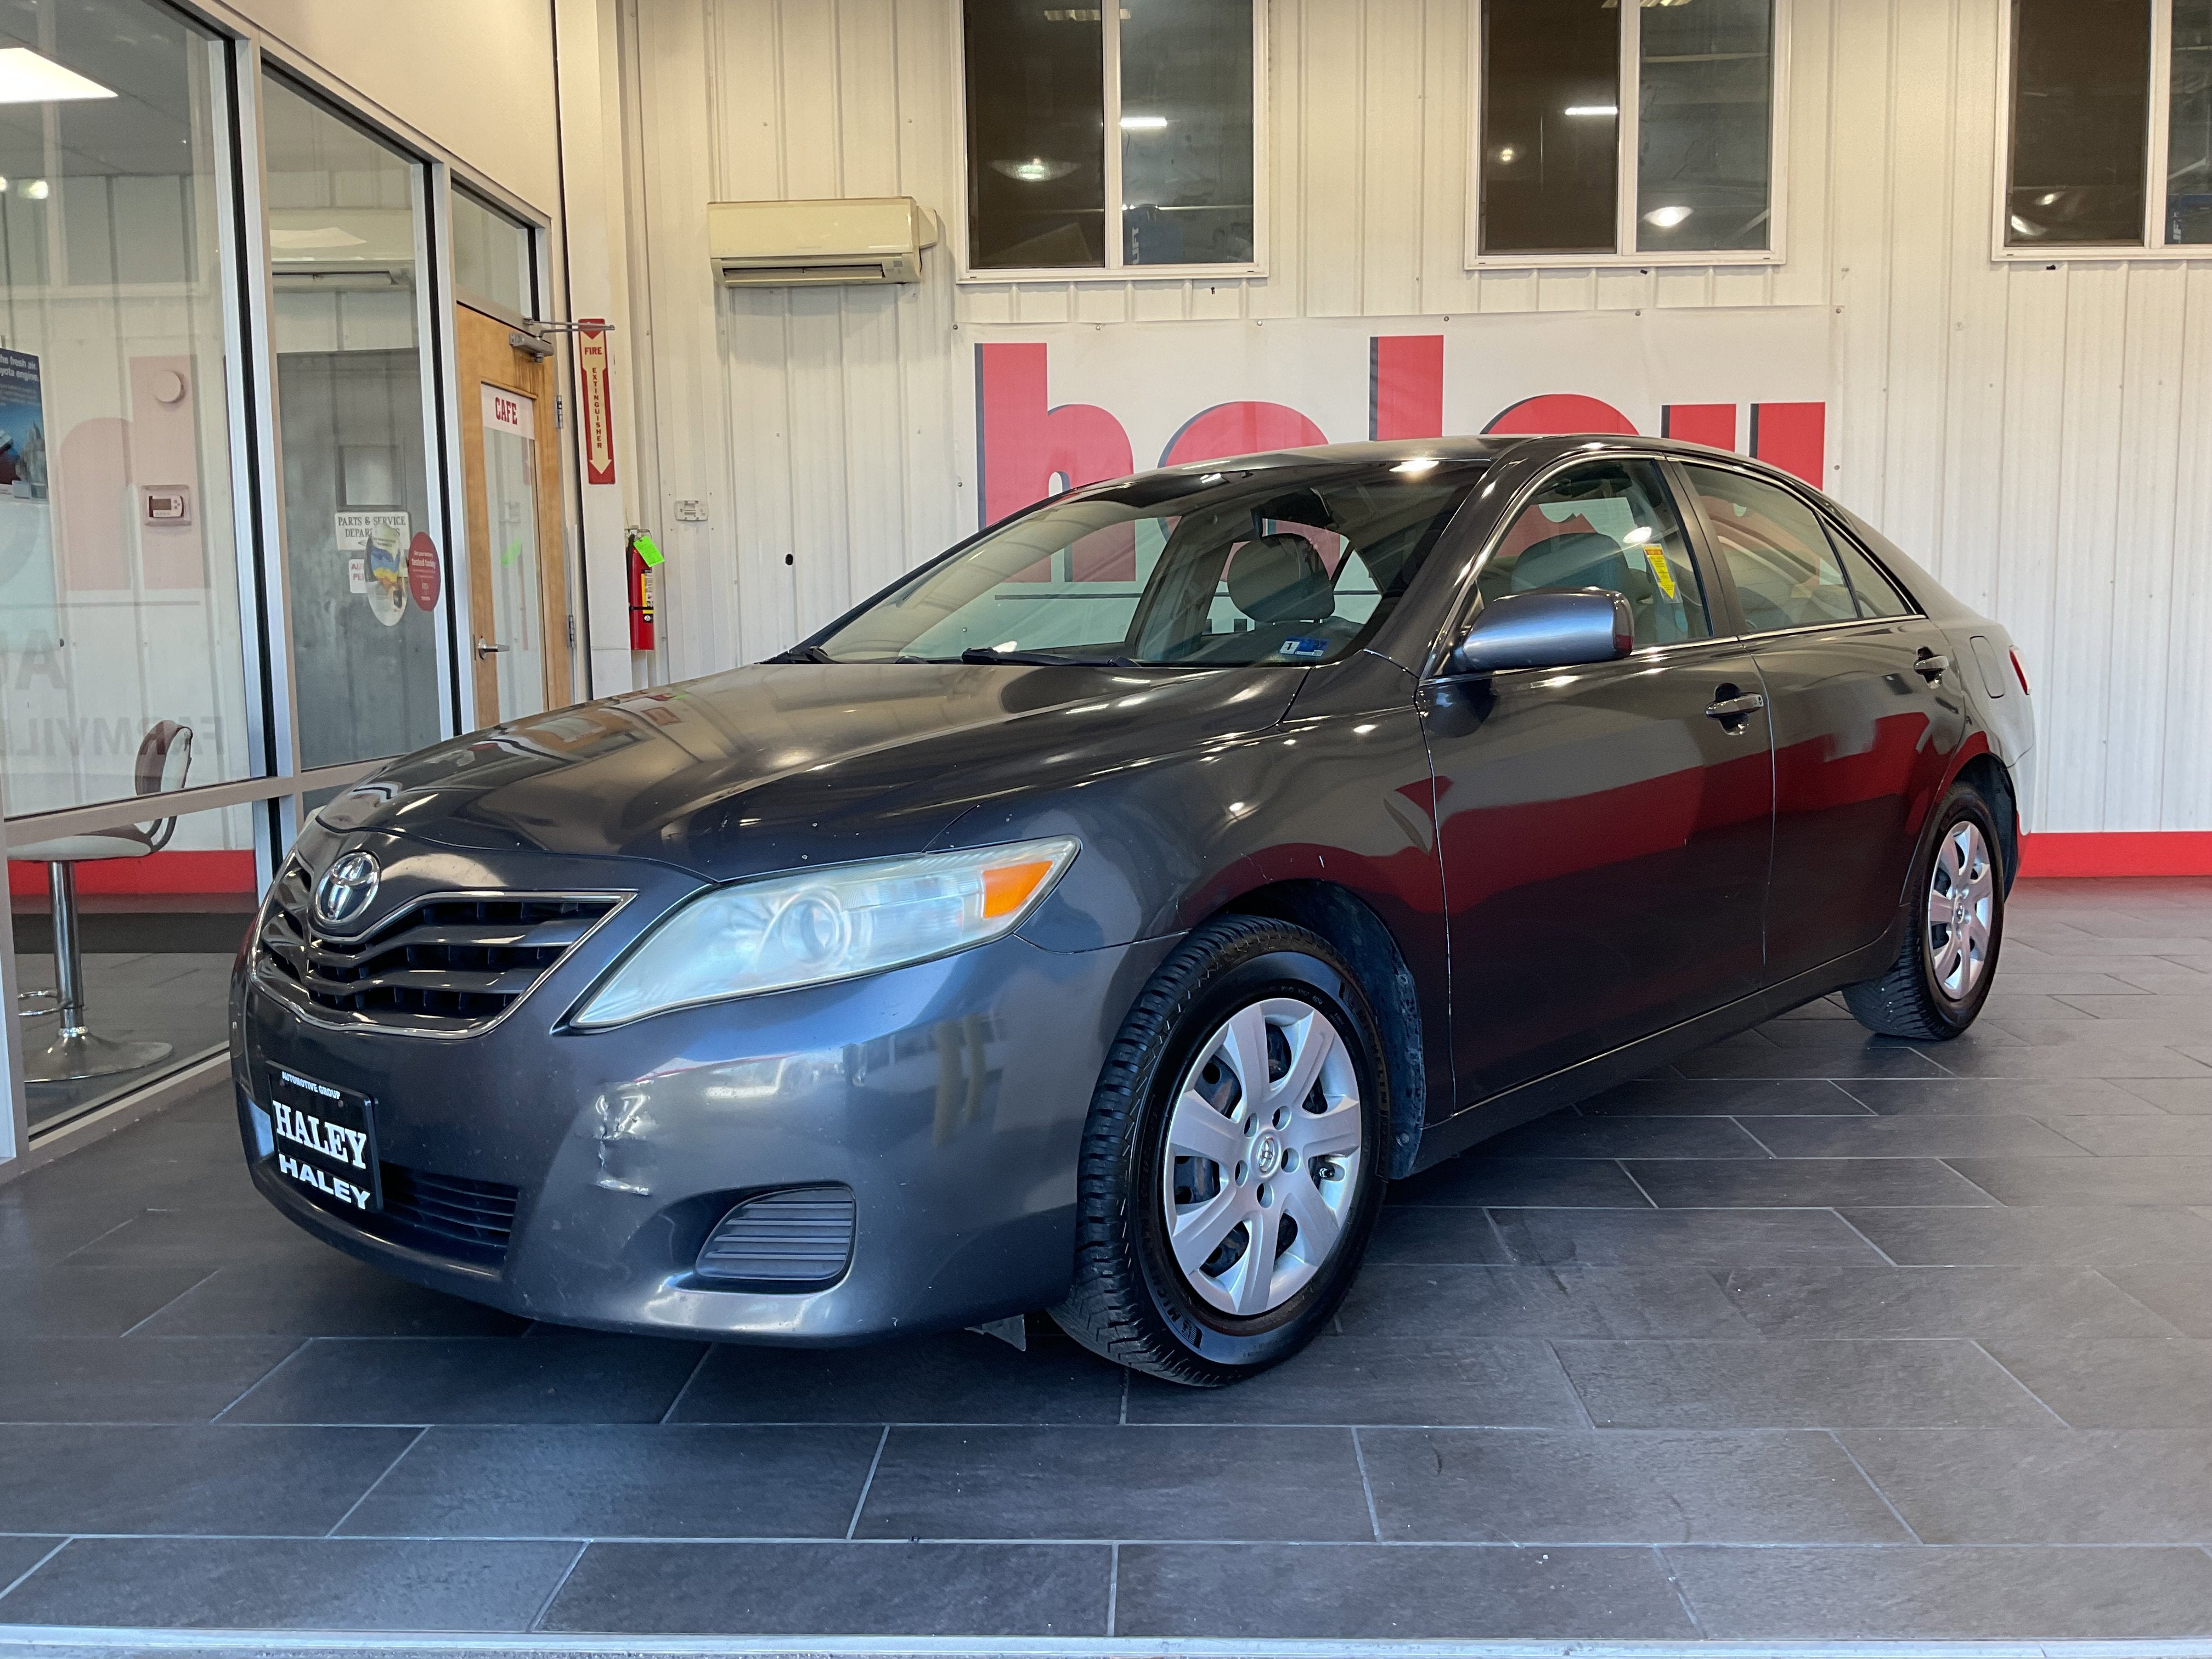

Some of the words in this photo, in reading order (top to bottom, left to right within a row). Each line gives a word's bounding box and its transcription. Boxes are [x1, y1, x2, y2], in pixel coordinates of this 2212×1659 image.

[0, 354, 8, 364] he
[585, 347, 602, 356] FIRE
[495, 397, 518, 425] CAFE
[592, 368, 602, 448] EXTINGUISHER
[338, 517, 362, 526] PARTS
[365, 516, 370, 526] &
[373, 516, 406, 526] SERVICE
[345, 528, 400, 538] DEPARS
[1286, 642, 1293, 651] 1
[281, 1071, 319, 1093] AUTOMOTIVE
[318, 1085, 341, 1100] GROUP
[272, 1099, 367, 1170] HALEY
[278, 1153, 371, 1210] HALEY
